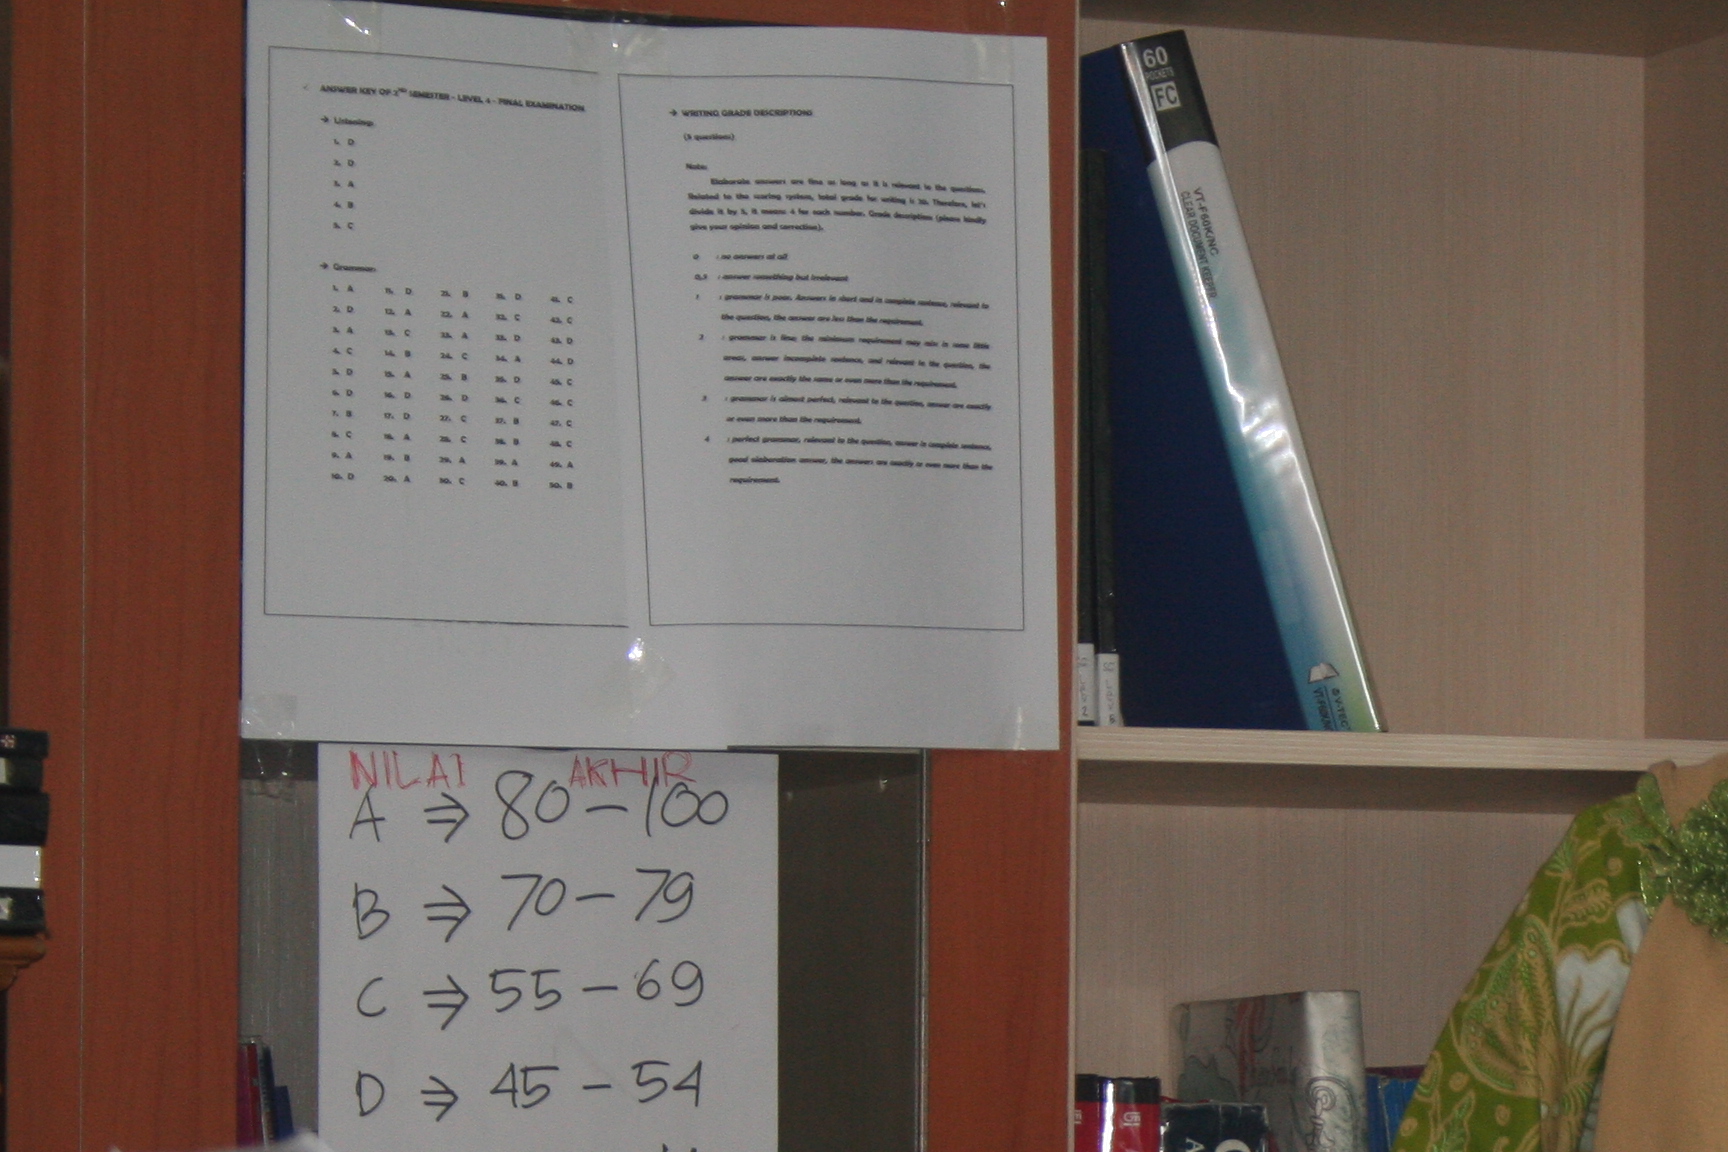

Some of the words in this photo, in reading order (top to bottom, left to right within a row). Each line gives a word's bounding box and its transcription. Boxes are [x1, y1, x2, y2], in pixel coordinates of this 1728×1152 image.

[1143, 46, 1168, 68] 60
[320, 84, 358, 94] ANSWER
[360, 86, 377, 95] KEY
[379, 87, 391, 96] OF
[409, 89, 450, 101] SEMESTER
[457, 93, 483, 104] LEVEL
[498, 97, 523, 107] FINAL
[525, 100, 585, 112] EXAMINATION
[681, 109, 719, 117] WRITING
[721, 109, 752, 117] GRADE
[753, 109, 813, 117] DESCRIPTIONS
[1154, 85, 1177, 108] FC
[1181, 190, 1195, 218] CLEAR
[1188, 220, 1209, 264] DOCUMENT
[1201, 265, 1218, 298] KEEPER
[350, 750, 468, 790] NILAI
[569, 750, 697, 788] AKHIR
[349, 783, 386, 842] A
[352, 881, 391, 940] B
[356, 976, 387, 1017] C
[355, 1070, 386, 1117] D
